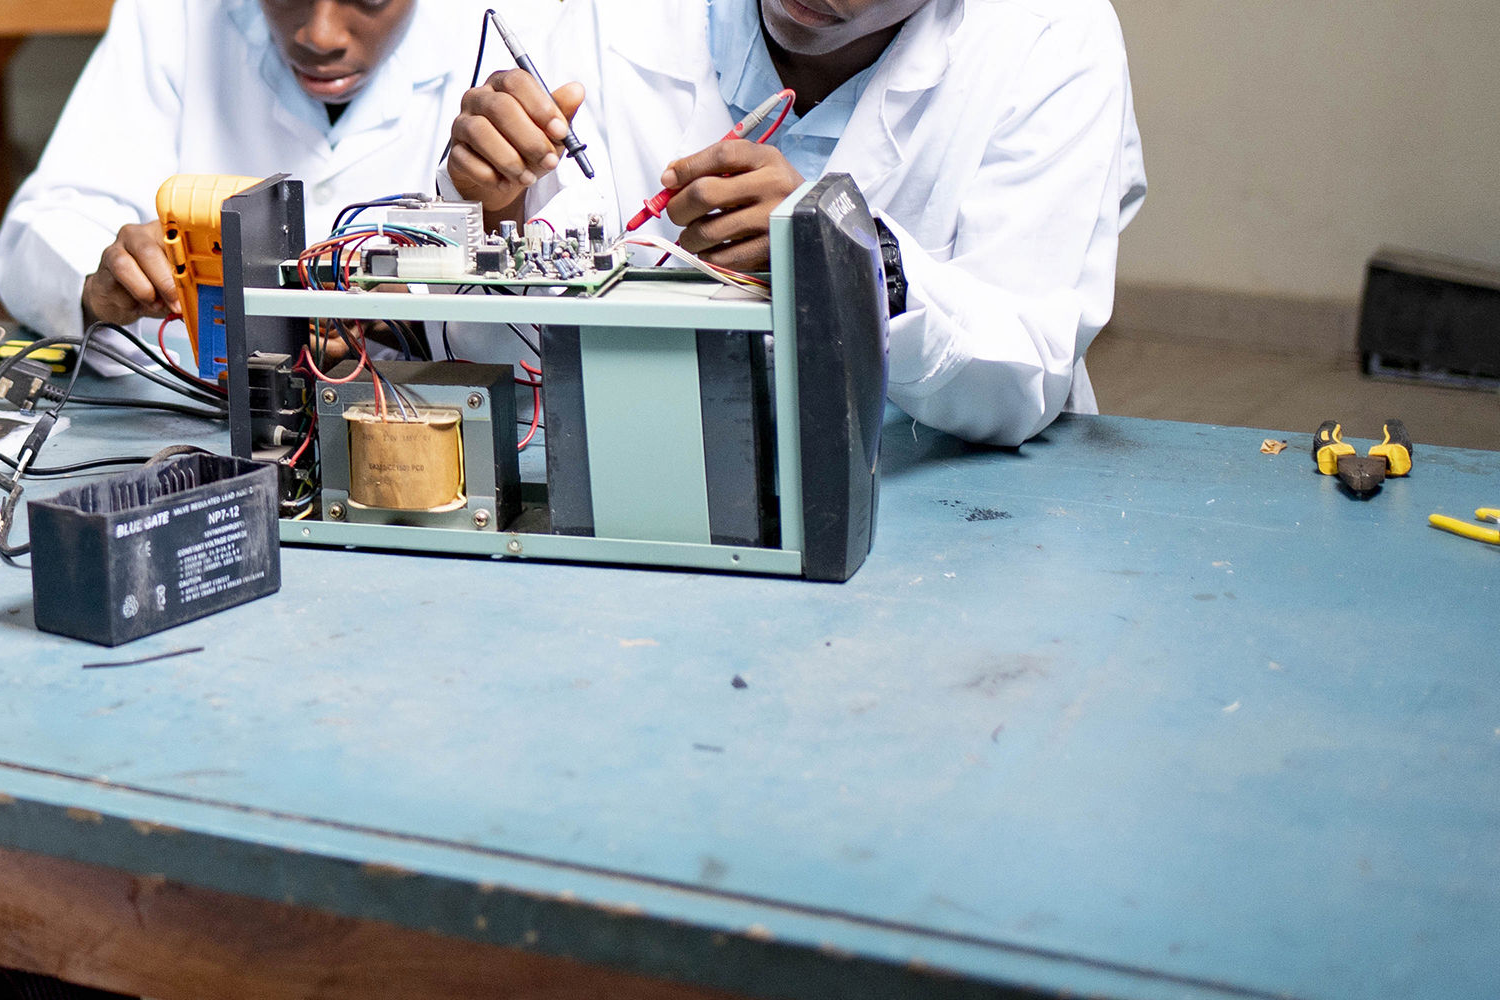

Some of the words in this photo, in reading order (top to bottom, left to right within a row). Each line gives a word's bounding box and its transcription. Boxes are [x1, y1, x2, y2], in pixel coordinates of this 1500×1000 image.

[173, 505, 189, 516] VALVE
[190, 496, 221, 511] REGULATED
[221, 492, 235, 502] LEAD
[208, 505, 240, 525] NP7-12
[177, 543, 204, 557] CONSTANT
[205, 536, 227, 549] VOLTAGE
